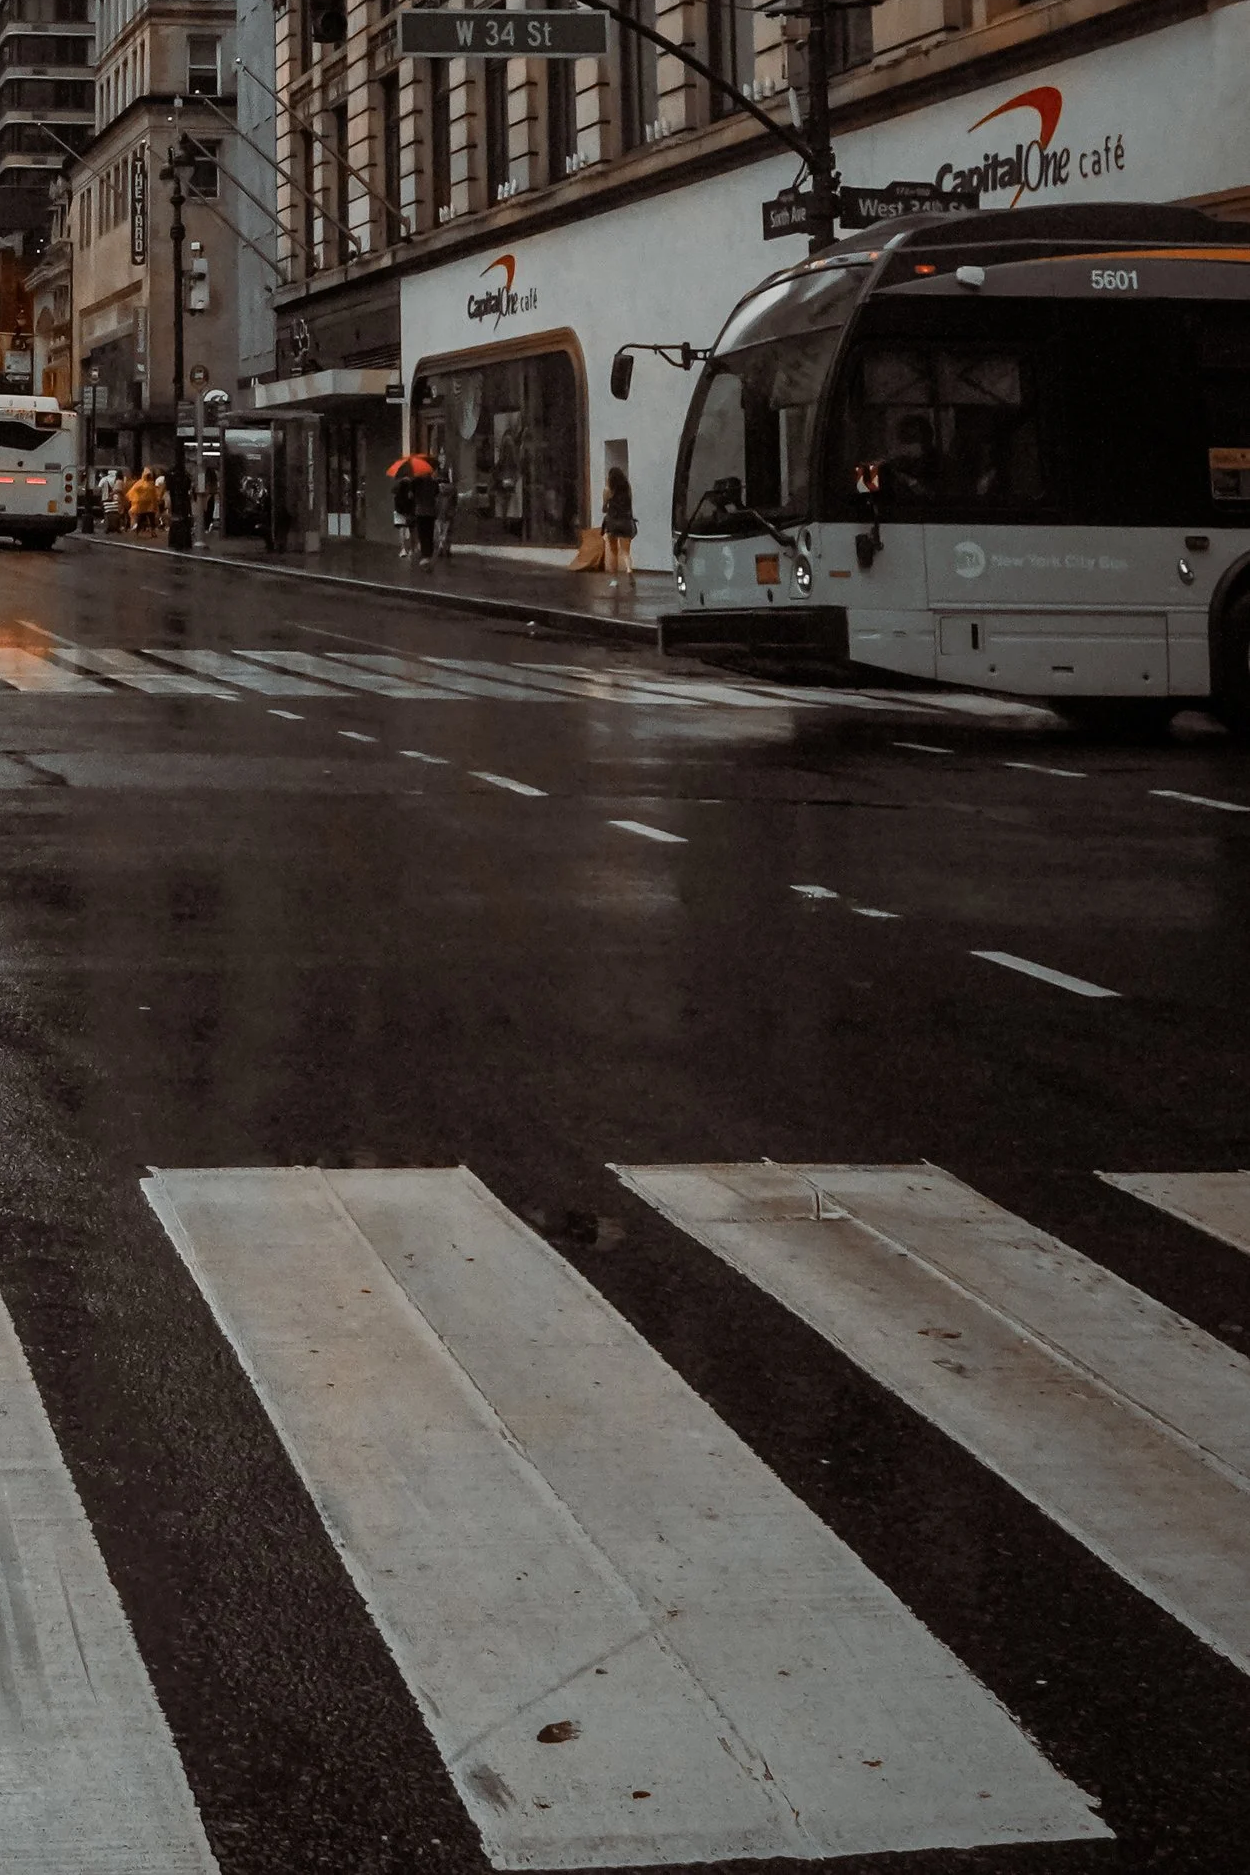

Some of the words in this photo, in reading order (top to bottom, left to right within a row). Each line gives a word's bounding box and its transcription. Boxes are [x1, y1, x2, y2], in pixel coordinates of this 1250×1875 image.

[456, 20, 474, 46] W
[485, 21, 515, 46] 34
[527, 21, 552, 46] St
[1079, 133, 1125, 178] café
[791, 206, 806, 223] Ave
[858, 198, 903, 217] West
[1092, 270, 1138, 290] 5601
